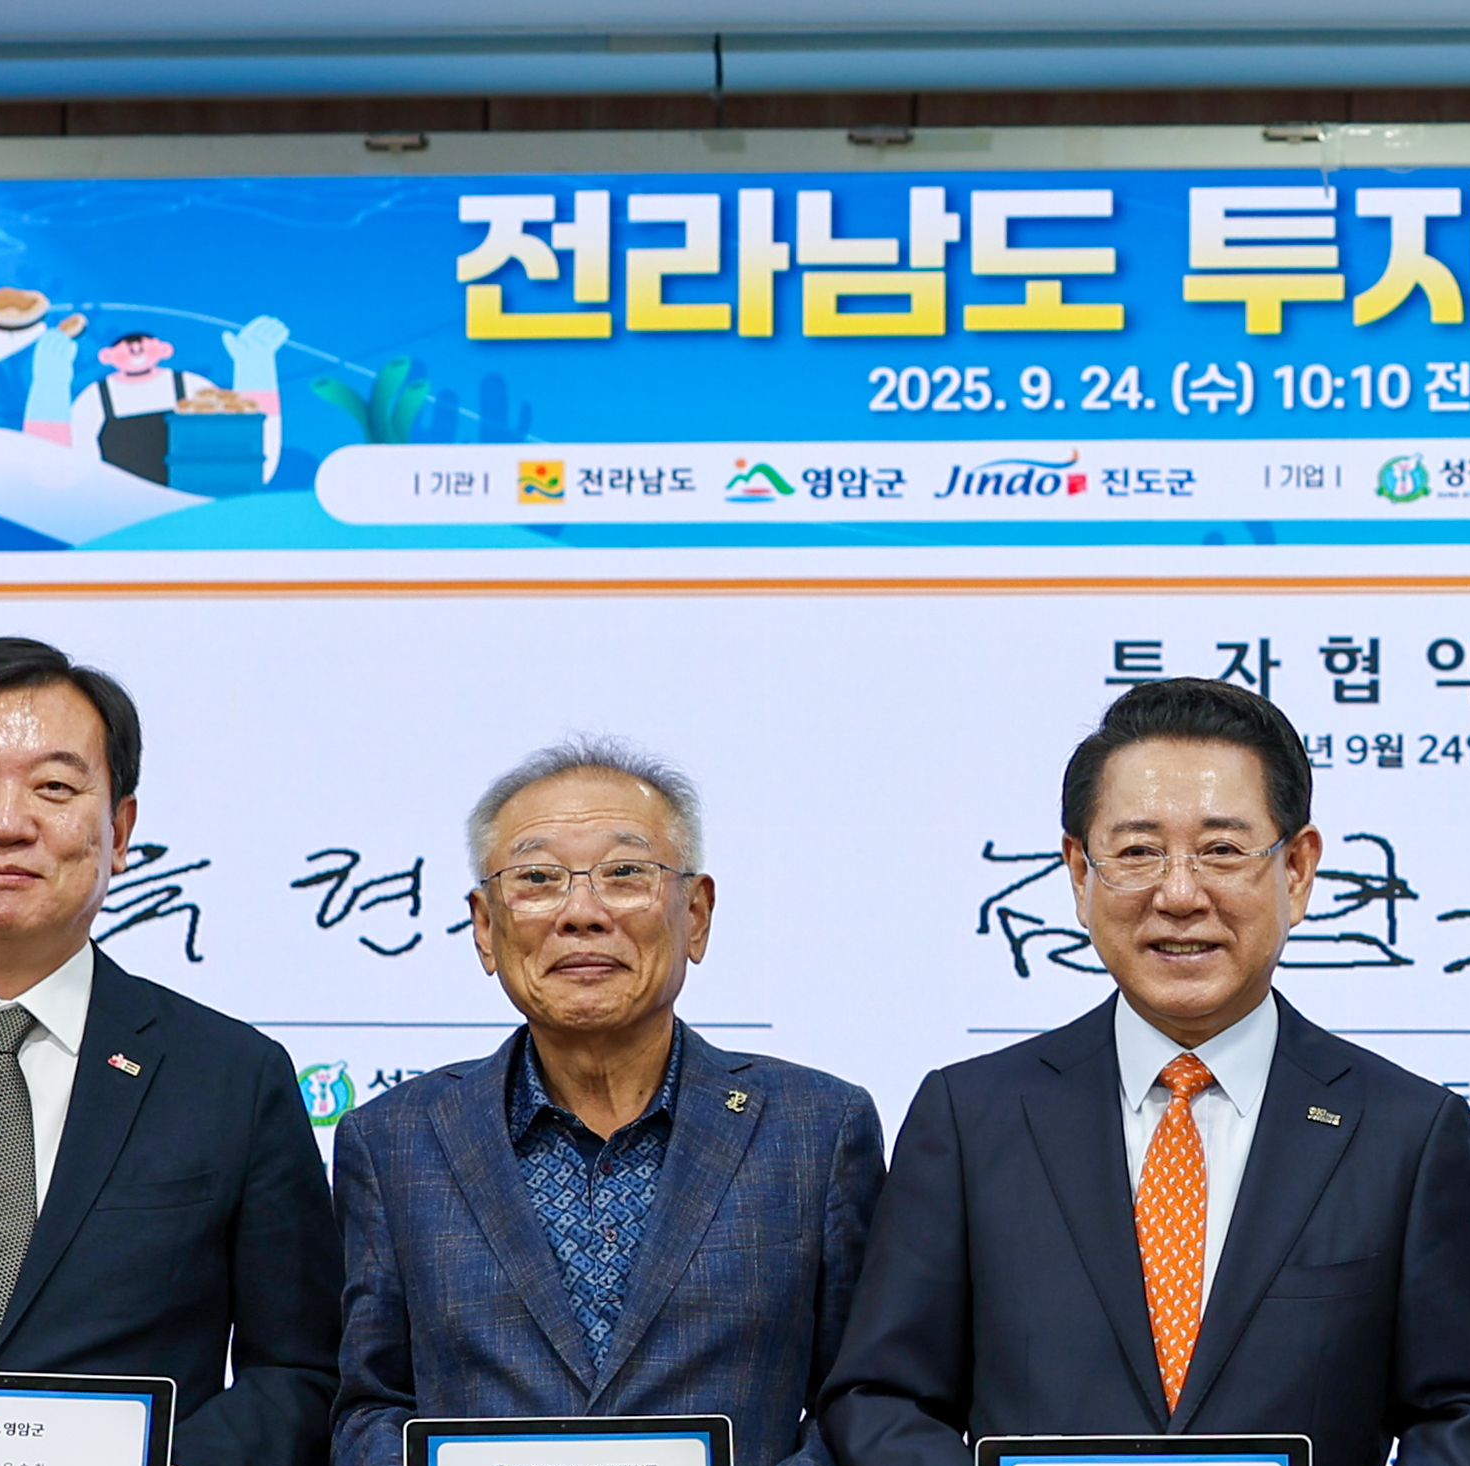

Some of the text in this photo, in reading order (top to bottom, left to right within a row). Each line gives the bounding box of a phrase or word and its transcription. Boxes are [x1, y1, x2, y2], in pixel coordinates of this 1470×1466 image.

[456, 186, 1124, 339] 전라남도
[868, 365, 1006, 411] 2025.
[1020, 366, 1065, 409] 9.
[1080, 364, 1155, 409] 24.
[1171, 360, 1253, 414] (수)
[1273, 363, 1410, 409] 10:10
[579, 467, 694, 495] 전라남도
[801, 467, 905, 498] 영암군
[934, 457, 1195, 499] Jindo 진도군
[1282, 465, 1323, 488] 기업
[1345, 733, 1403, 768] 9월
[3, 1422, 45, 1437] 영암군
